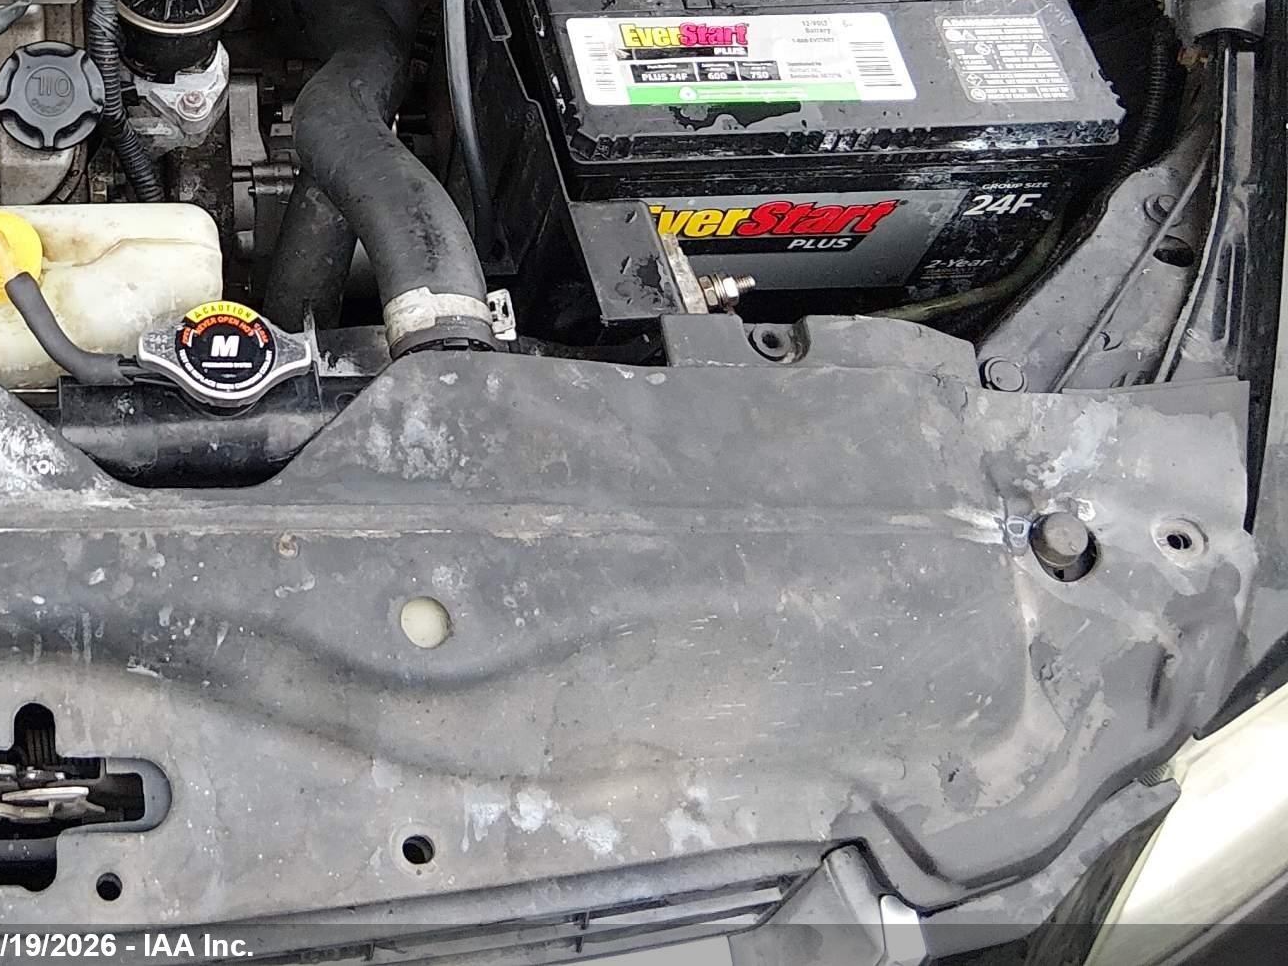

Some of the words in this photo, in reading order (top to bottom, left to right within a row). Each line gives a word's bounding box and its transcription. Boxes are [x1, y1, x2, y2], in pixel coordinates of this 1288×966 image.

[619, 22, 748, 47] EverStart
[713, 46, 746, 56] PLUS
[641, 72, 668, 82] PLUS
[707, 71, 728, 80] 600
[750, 70, 770, 80] 750
[982, 183, 1024, 191] GROUP
[963, 193, 1043, 216] 24F
[787, 237, 853, 250] PLUS
[923, 258, 994, 269] 2-Year
[201, 304, 253, 320] CAUTION
[196, 316, 217, 335] NEVER
[216, 316, 240, 327] OPEN
[210, 335, 240, 357] M
